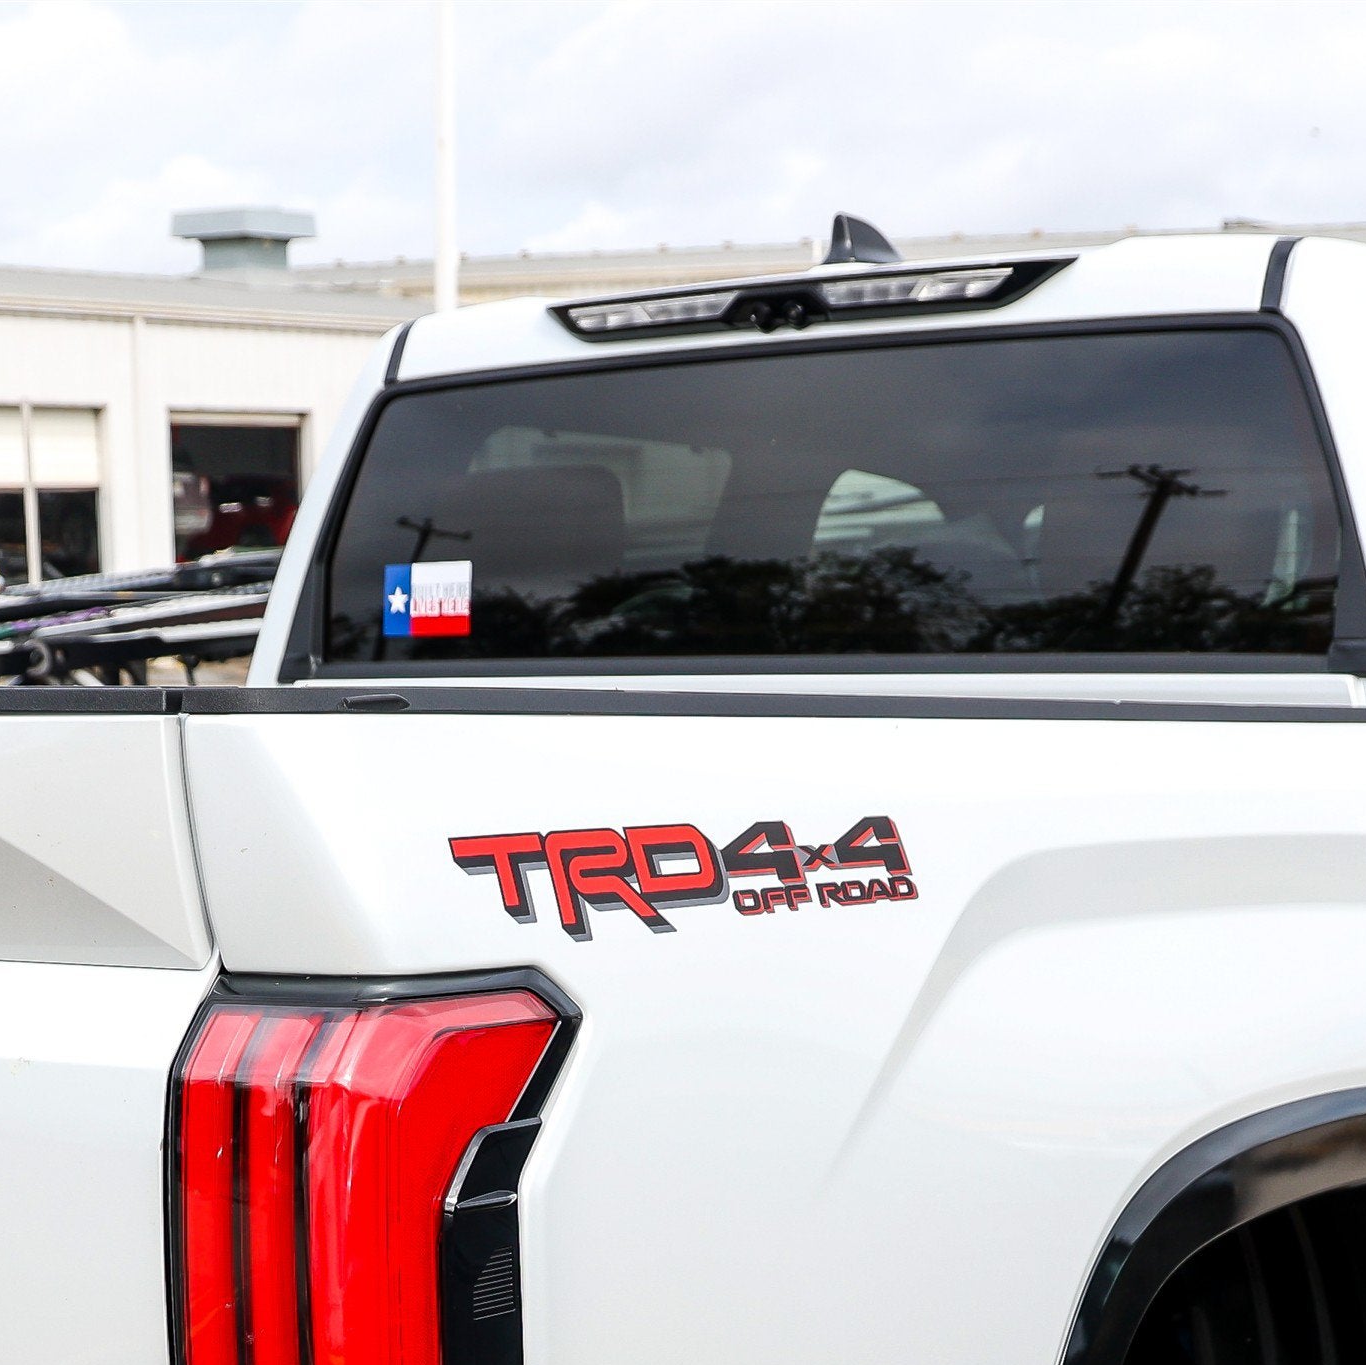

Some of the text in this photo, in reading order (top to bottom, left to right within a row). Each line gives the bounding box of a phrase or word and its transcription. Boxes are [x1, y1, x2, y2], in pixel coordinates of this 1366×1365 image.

[448, 823, 730, 943] TRD
[732, 876, 920, 917] OFF ROAD
